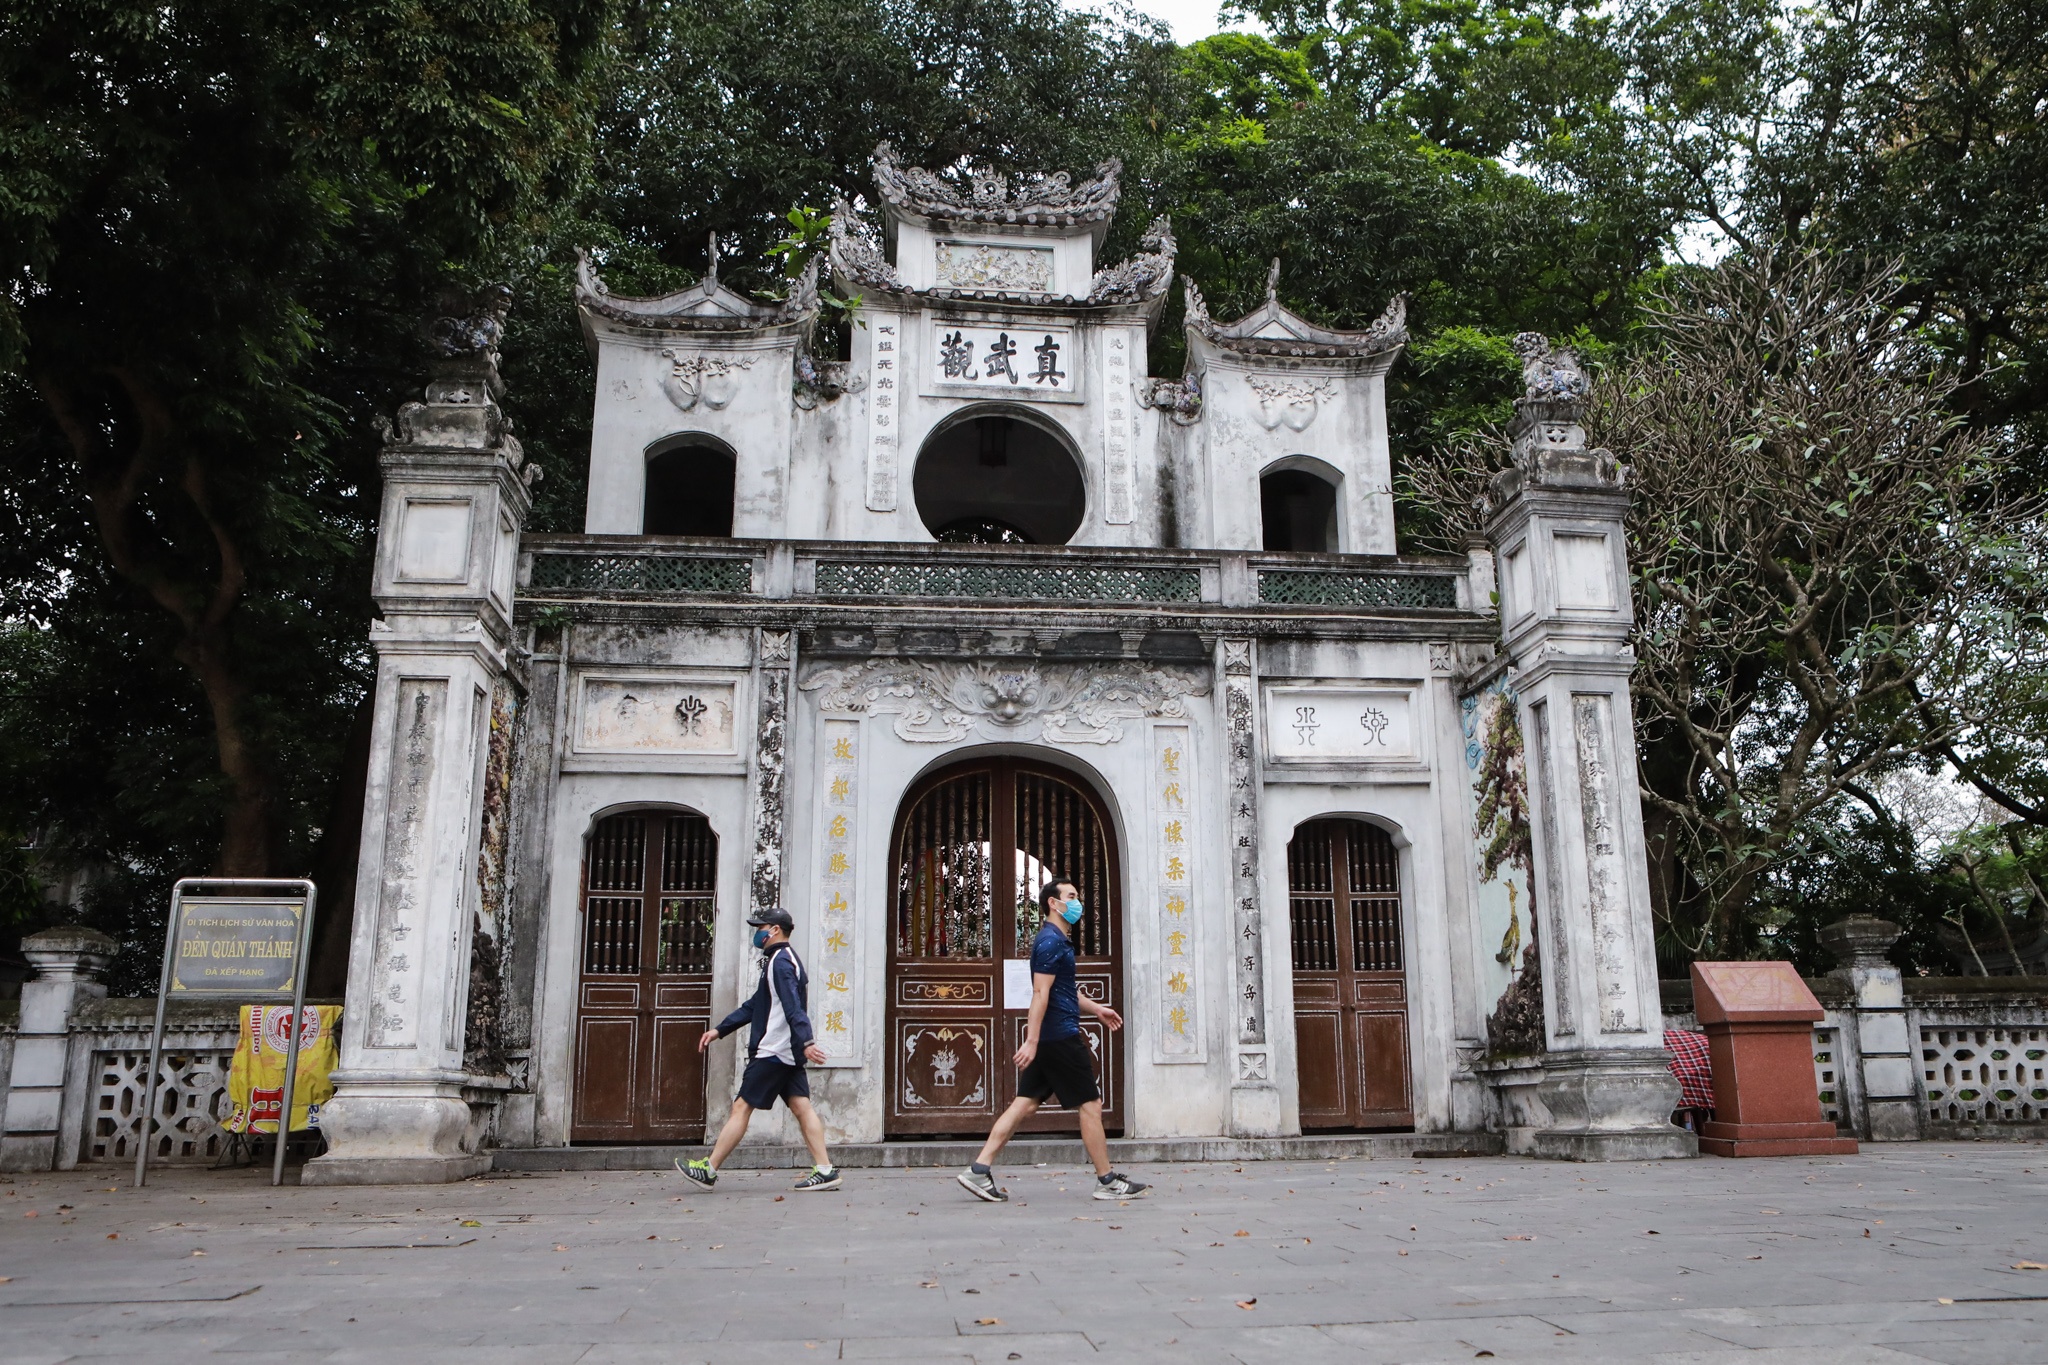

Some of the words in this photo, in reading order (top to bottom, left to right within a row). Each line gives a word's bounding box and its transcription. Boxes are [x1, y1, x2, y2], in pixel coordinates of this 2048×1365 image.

[220, 919, 240, 928] LỊCH
[256, 918, 274, 927] VĂN
[182, 931, 210, 958] ĐỀN
[212, 935, 246, 958] QUÁN
[249, 935, 293, 958] THÁNH
[239, 968, 265, 978] HẠNG
